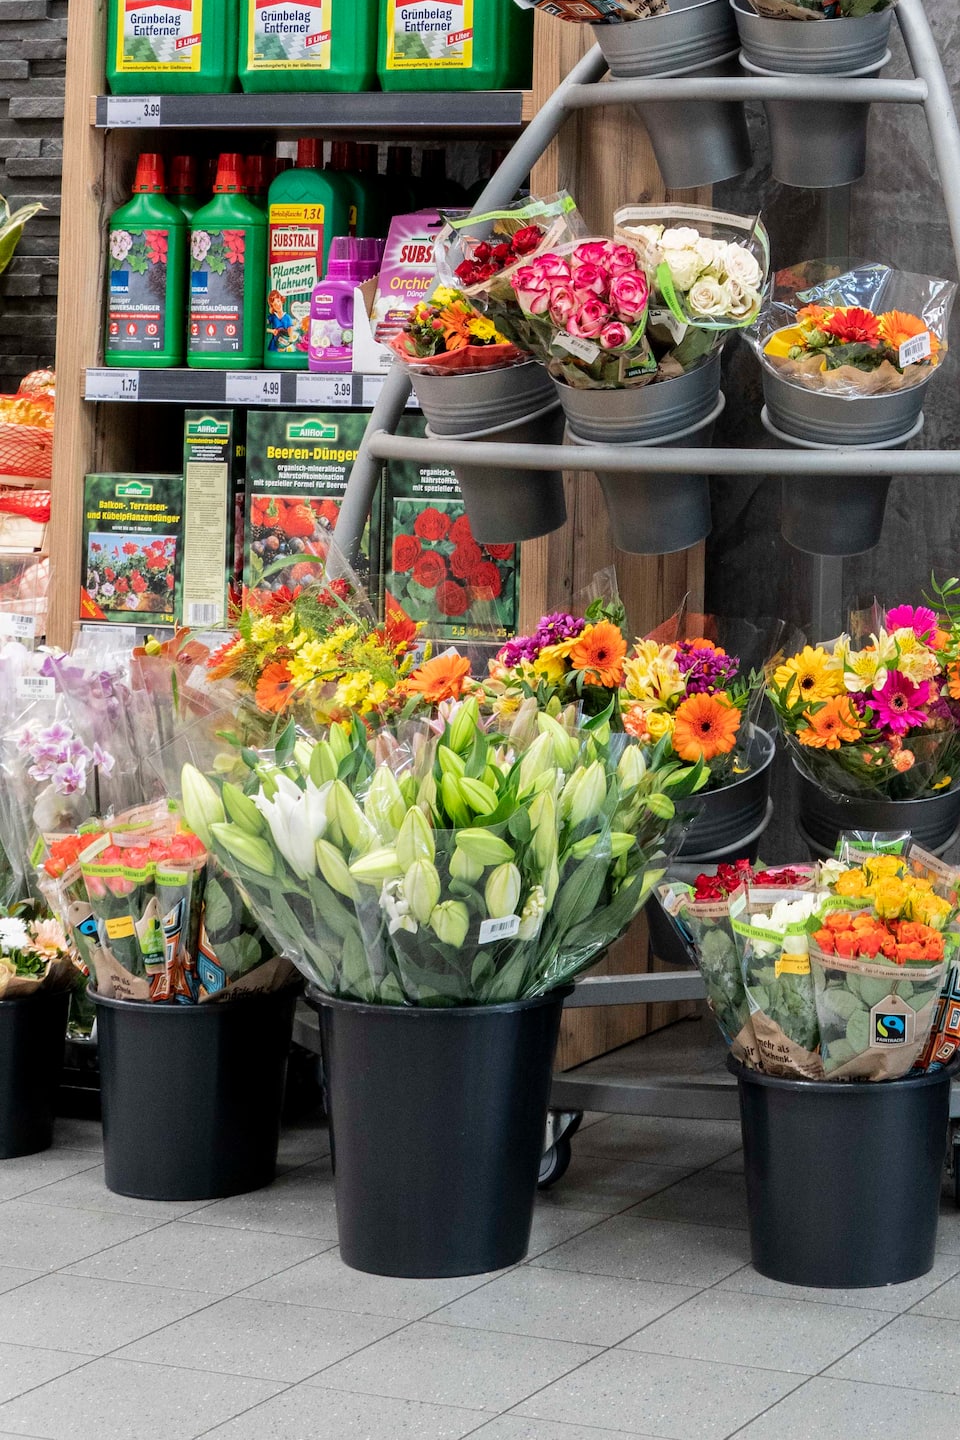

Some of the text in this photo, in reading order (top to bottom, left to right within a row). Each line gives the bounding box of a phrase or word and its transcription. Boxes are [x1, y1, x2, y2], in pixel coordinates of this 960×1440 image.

[130, 13, 182, 27] Grünbelag
[261, 10, 312, 23] Grünbelag
[401, 8, 453, 21] Grünbelag
[134, 25, 181, 36] Entferner
[264, 22, 310, 33] Entferner
[404, 20, 452, 32] Entferner
[183, 37, 199, 46] Liter
[313, 34, 329, 42] Liter
[455, 31, 470, 40] Liter
[144, 104, 160, 117] 3.99
[273, 233, 316, 248] SUBSTRAL
[399, 244, 437, 263] SUBS
[272, 263, 316, 279] Pflanzen-
[275, 276, 314, 291] Nahrung
[121, 379, 137, 392] 1.79
[263, 382, 279, 395] 4.99
[334, 383, 351, 396] 3.99
[197, 425, 219, 433] Allflor
[299, 428, 324, 437] Allflor
[266, 446, 359, 462] Beeren-Dünger
[277, 464, 346, 474] organisch-mineralische
[278, 472, 344, 481] Nährstoffkombination
[420, 477, 459, 485] Nährstoffko
[265, 480, 293, 488] spezieller
[293, 480, 315, 488] Formel
[315, 480, 326, 489] für
[326, 481, 347, 489] Beeren
[424, 485, 454, 493] spezieller
[98, 500, 169, 512] Balkon-, Terrassen-
[86, 511, 181, 524] und Kübelpflanzendünger
[165, 615, 174, 623] kg
[451, 626, 466, 637] 2,5
